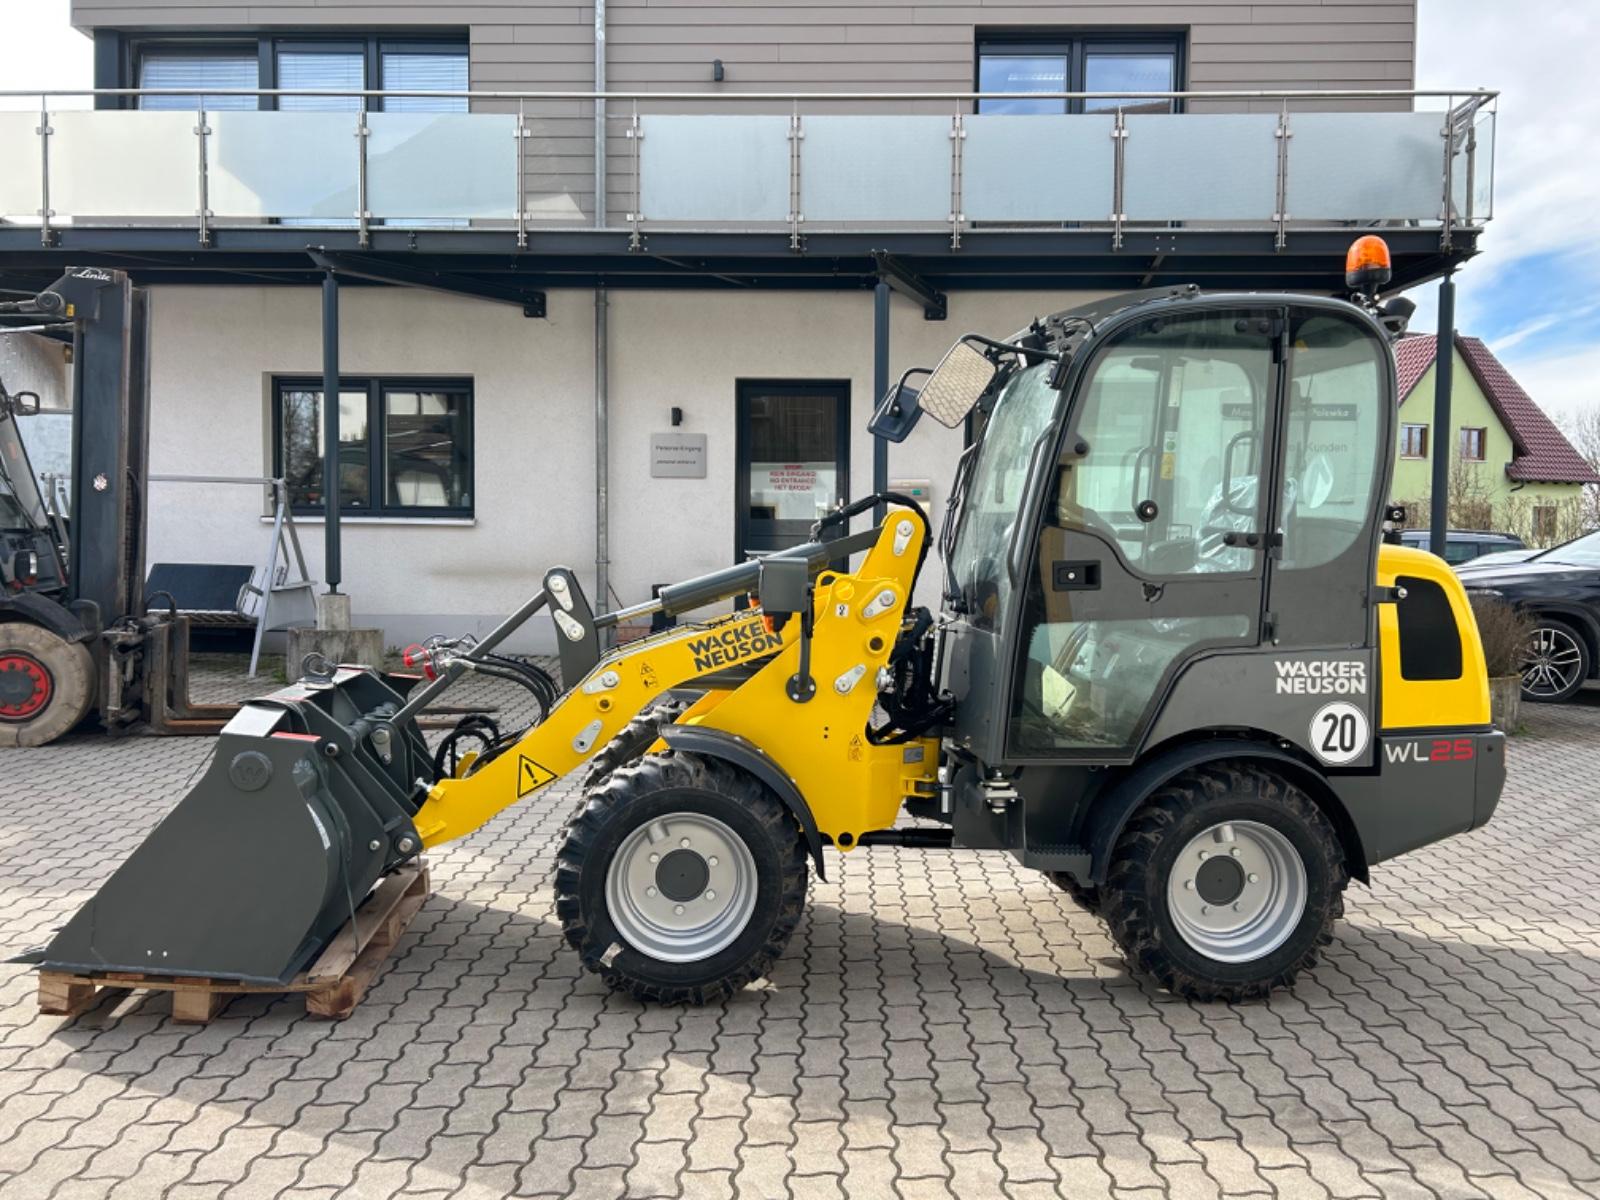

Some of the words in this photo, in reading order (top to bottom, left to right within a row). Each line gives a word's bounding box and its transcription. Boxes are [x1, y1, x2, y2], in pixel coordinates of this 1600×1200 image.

[687, 620, 767, 656] WACKE
[693, 631, 783, 672] NEUSON
[1274, 661, 1367, 677] WACKER
[1276, 677, 1367, 694] NEUSON
[1321, 712, 1357, 752] 20
